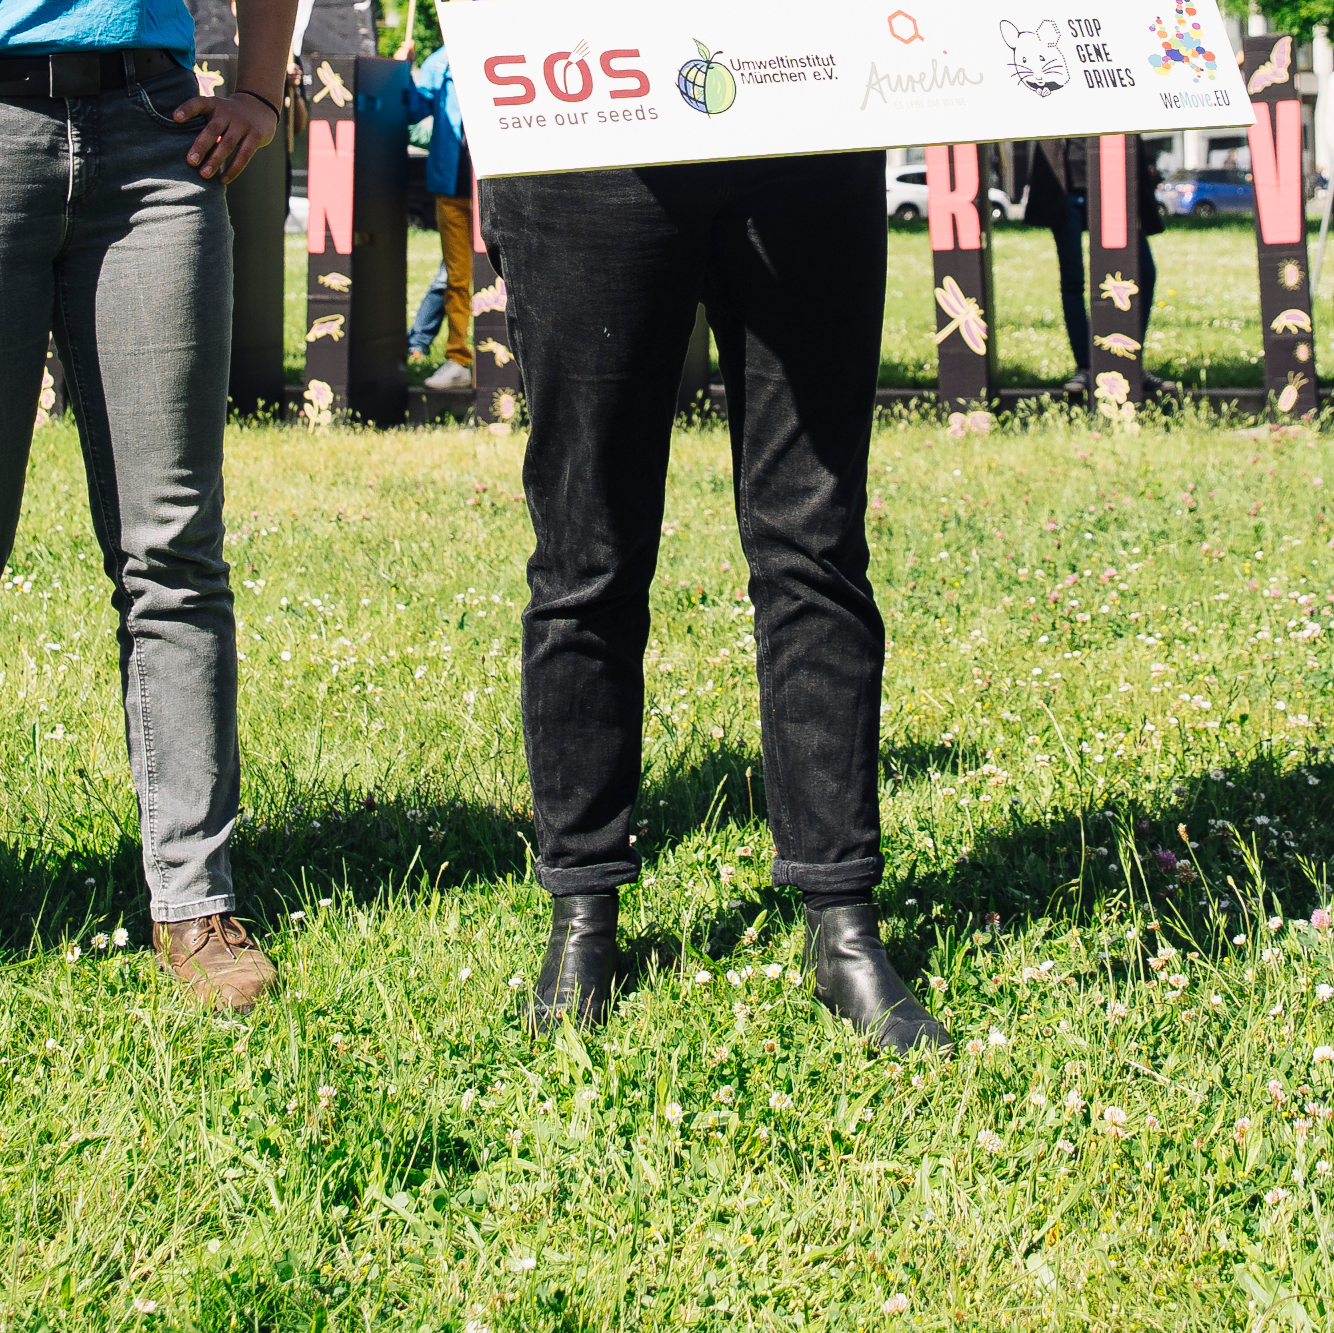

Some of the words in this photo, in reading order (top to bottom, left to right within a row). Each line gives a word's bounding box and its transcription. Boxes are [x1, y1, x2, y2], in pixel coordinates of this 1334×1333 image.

[1068, 19, 1102, 38] STOP
[729, 54, 837, 72] Umweltinstitut
[1076, 43, 1113, 63] GENE
[483, 45, 651, 107] SOS
[740, 68, 807, 85] München
[813, 67, 839, 82] e.V.
[860, 50, 984, 111] Aurelia
[1083, 68, 1136, 89] DRIVES
[1160, 90, 1231, 109] WeMove.EU
[499, 112, 547, 130] save
[554, 109, 589, 126] our
[597, 105, 659, 124] seeds
